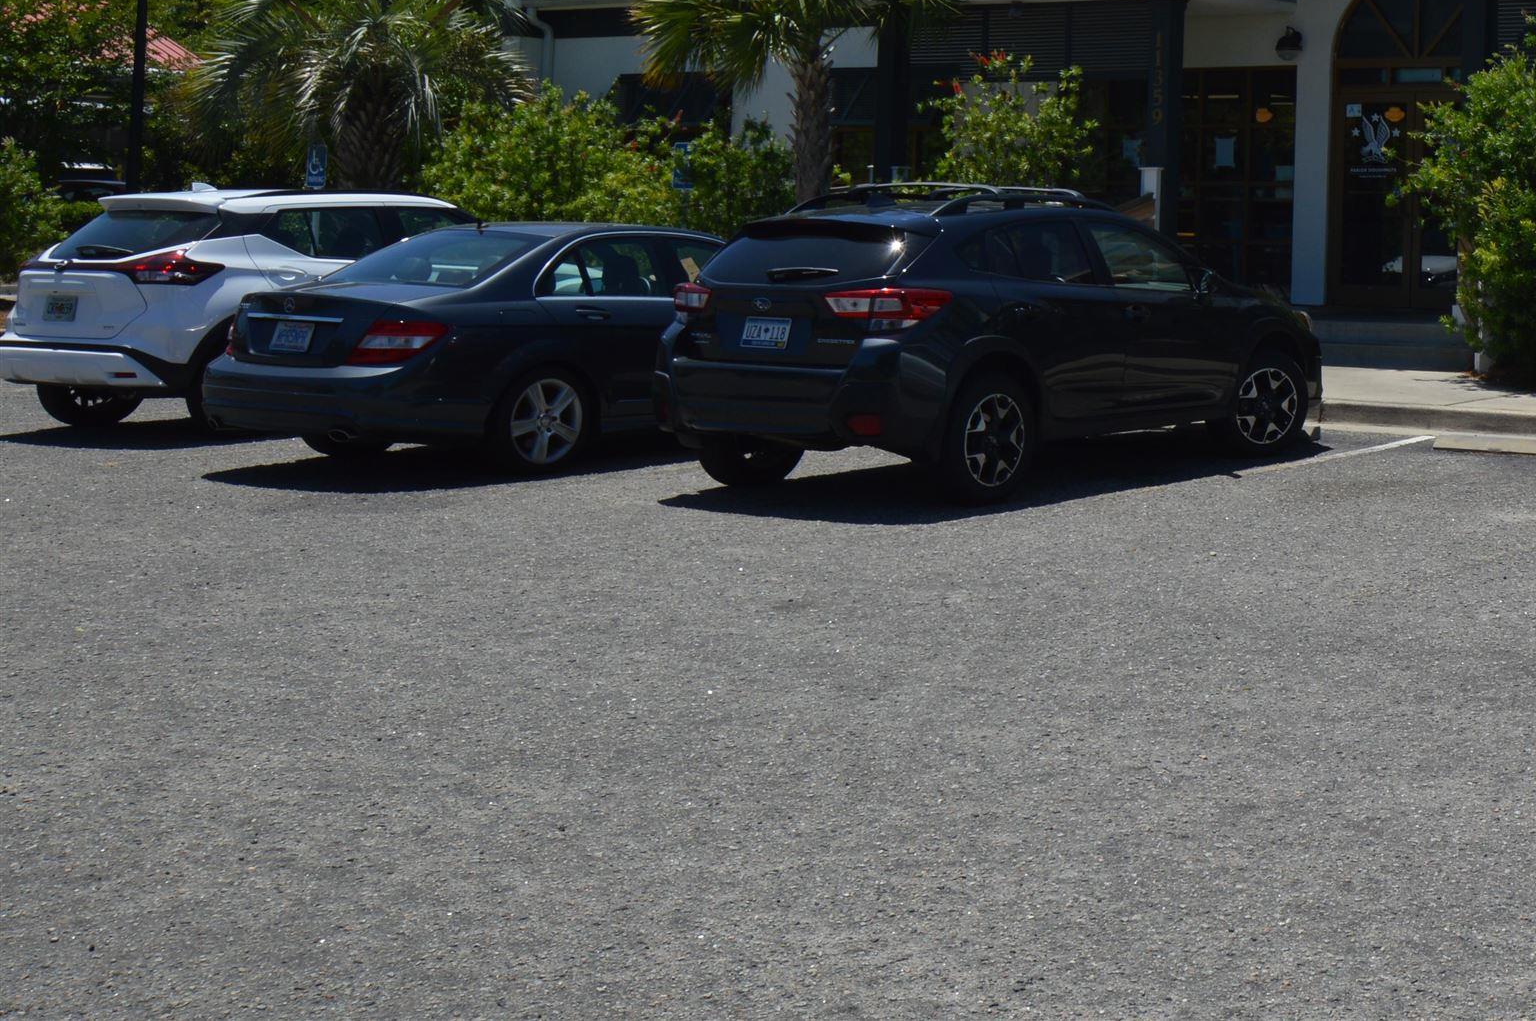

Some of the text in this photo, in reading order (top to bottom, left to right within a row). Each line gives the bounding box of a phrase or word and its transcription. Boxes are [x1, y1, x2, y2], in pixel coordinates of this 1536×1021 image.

[1152, 32, 1165, 126] 1359
[745, 322, 787, 340] UZA 118
